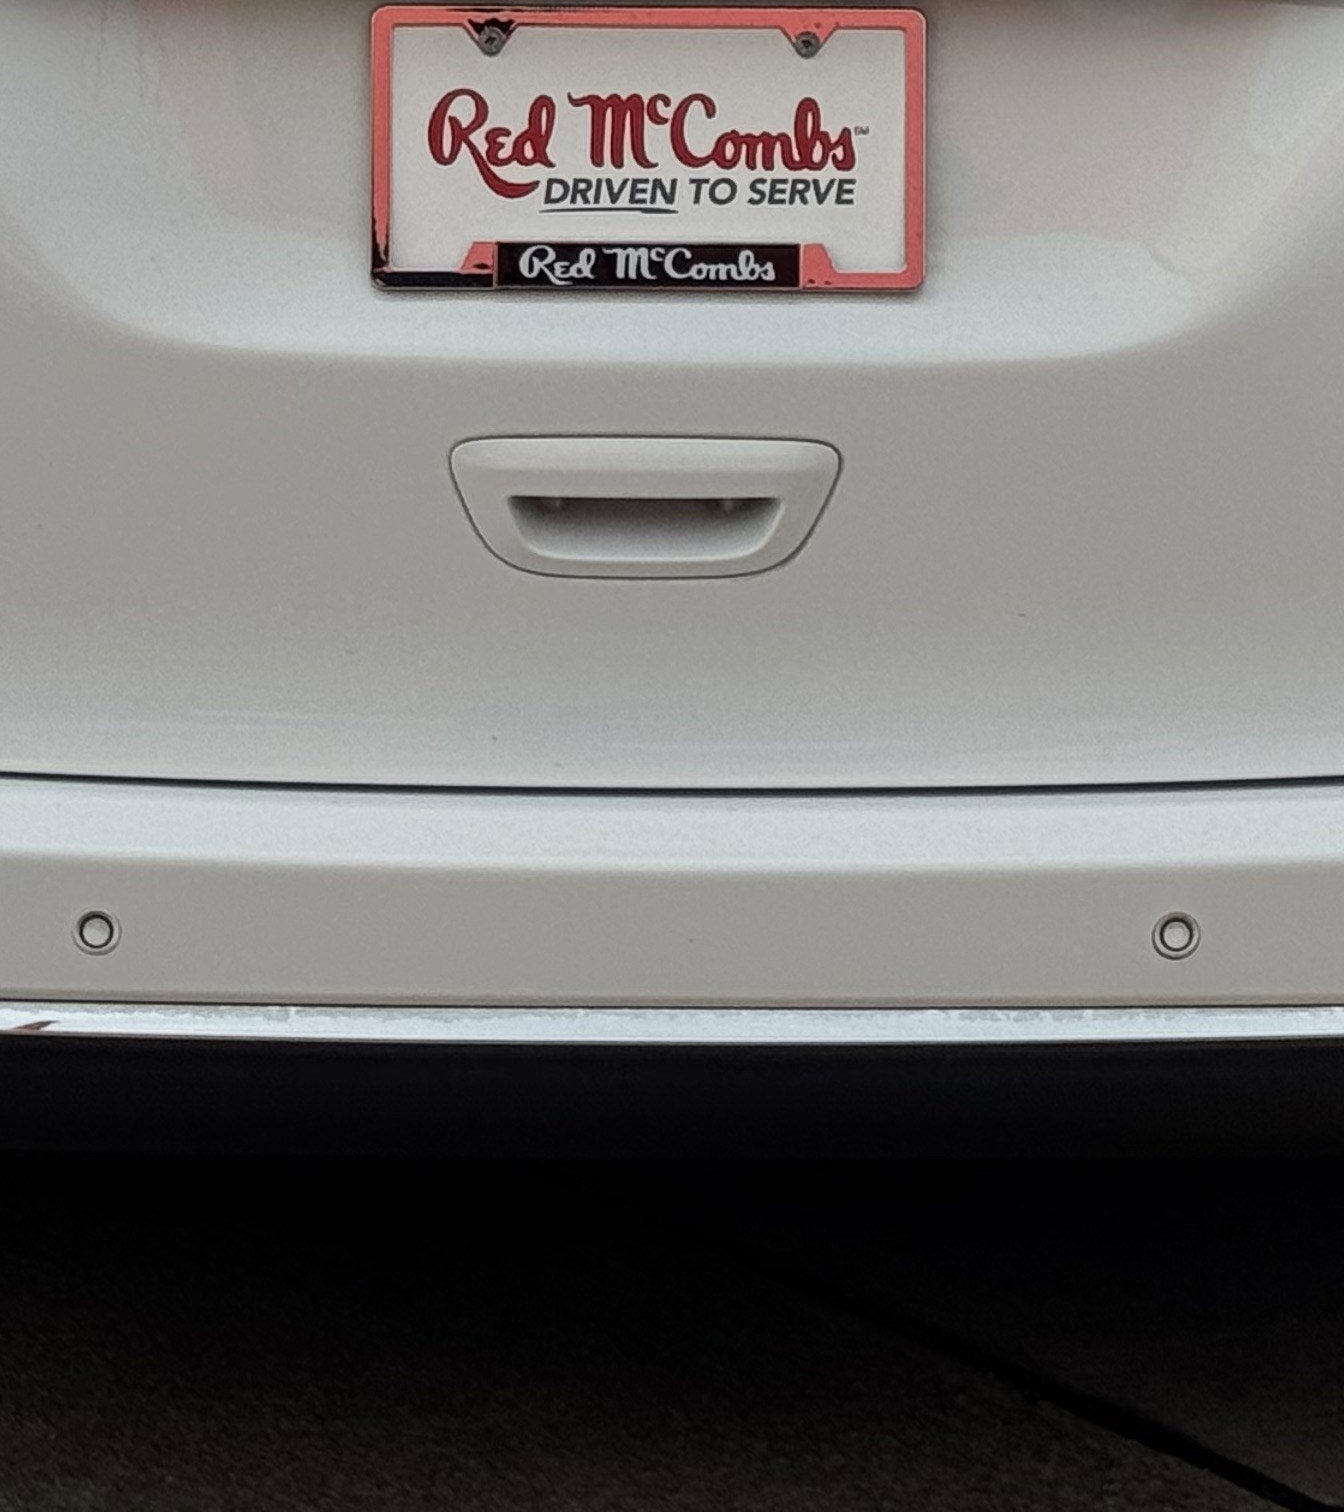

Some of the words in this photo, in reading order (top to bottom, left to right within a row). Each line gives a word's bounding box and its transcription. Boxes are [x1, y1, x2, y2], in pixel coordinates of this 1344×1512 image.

[428, 88, 556, 199] Red
[567, 92, 856, 171] McCombs
[543, 177, 678, 206] DRIVEN
[689, 177, 739, 206] TO
[747, 177, 857, 206] SERVE
[518, 244, 594, 285] Red
[602, 246, 776, 282] McCombs
